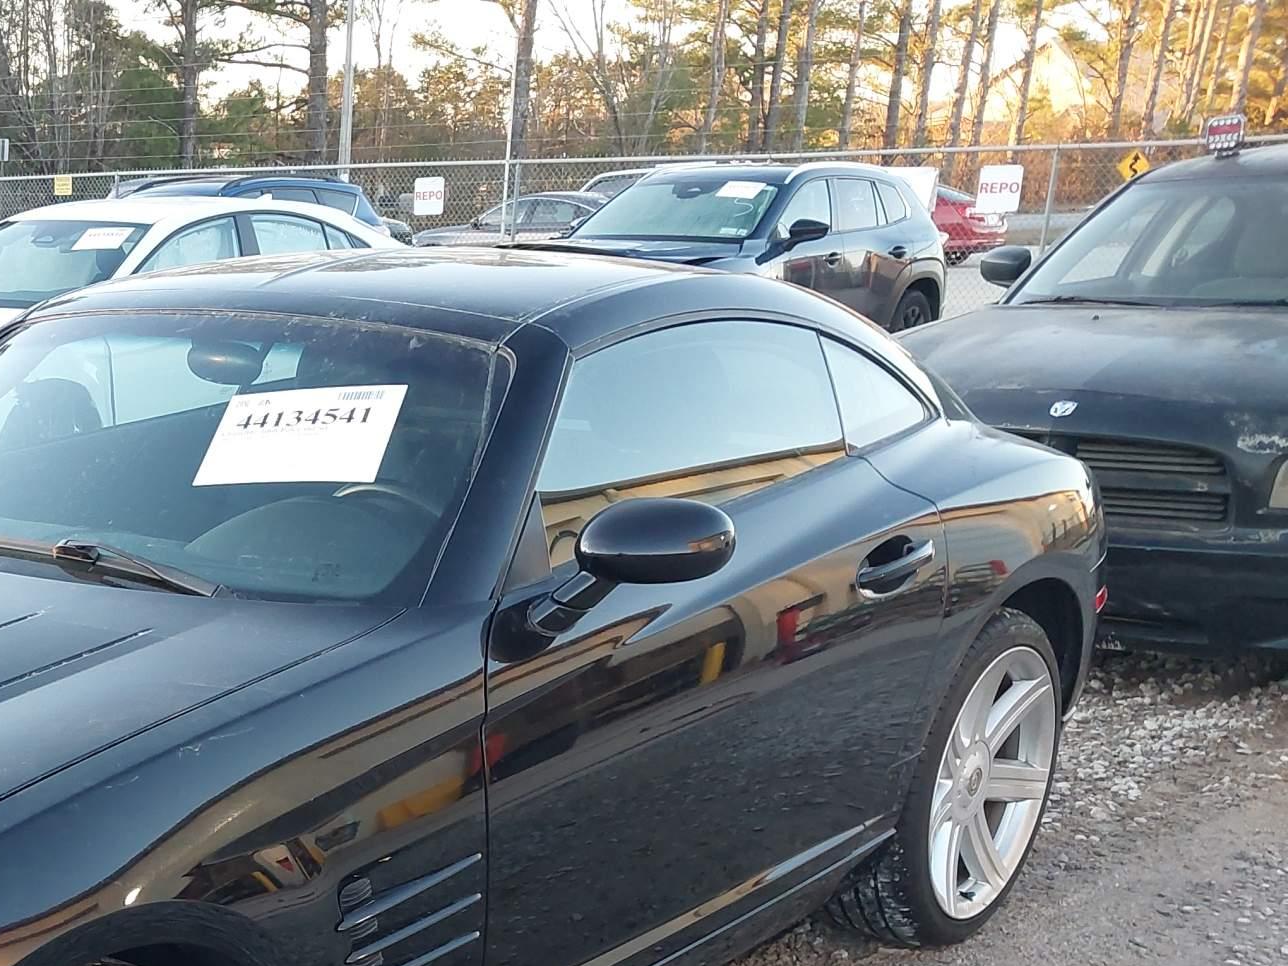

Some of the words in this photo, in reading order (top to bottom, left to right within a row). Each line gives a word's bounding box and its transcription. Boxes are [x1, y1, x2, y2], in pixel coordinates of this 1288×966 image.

[979, 182, 1020, 194] REPO
[415, 191, 443, 201] REPO
[236, 407, 372, 429] 44134541
